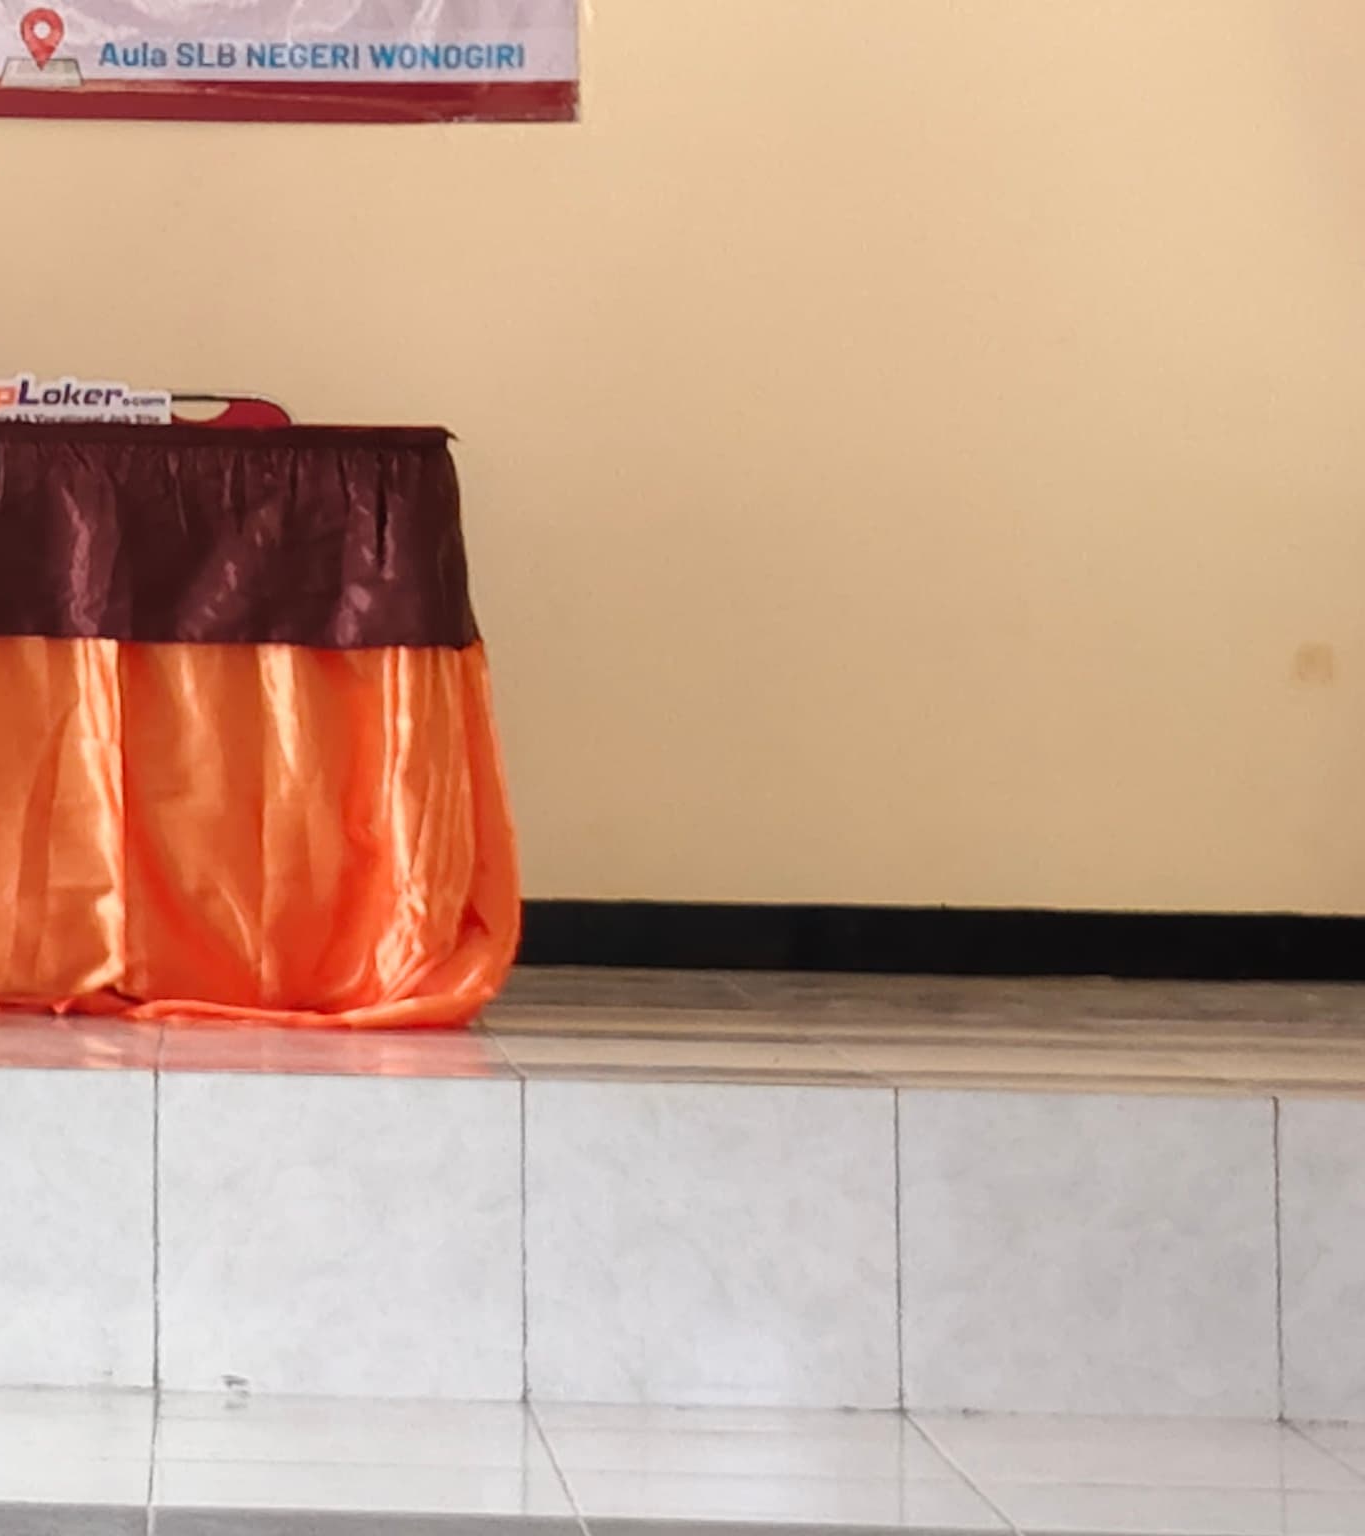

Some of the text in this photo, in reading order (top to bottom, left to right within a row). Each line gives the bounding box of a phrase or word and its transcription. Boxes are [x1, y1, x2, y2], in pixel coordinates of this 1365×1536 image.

[98, 41, 526, 70] Aula SLB NEGERI WONOGIRI
